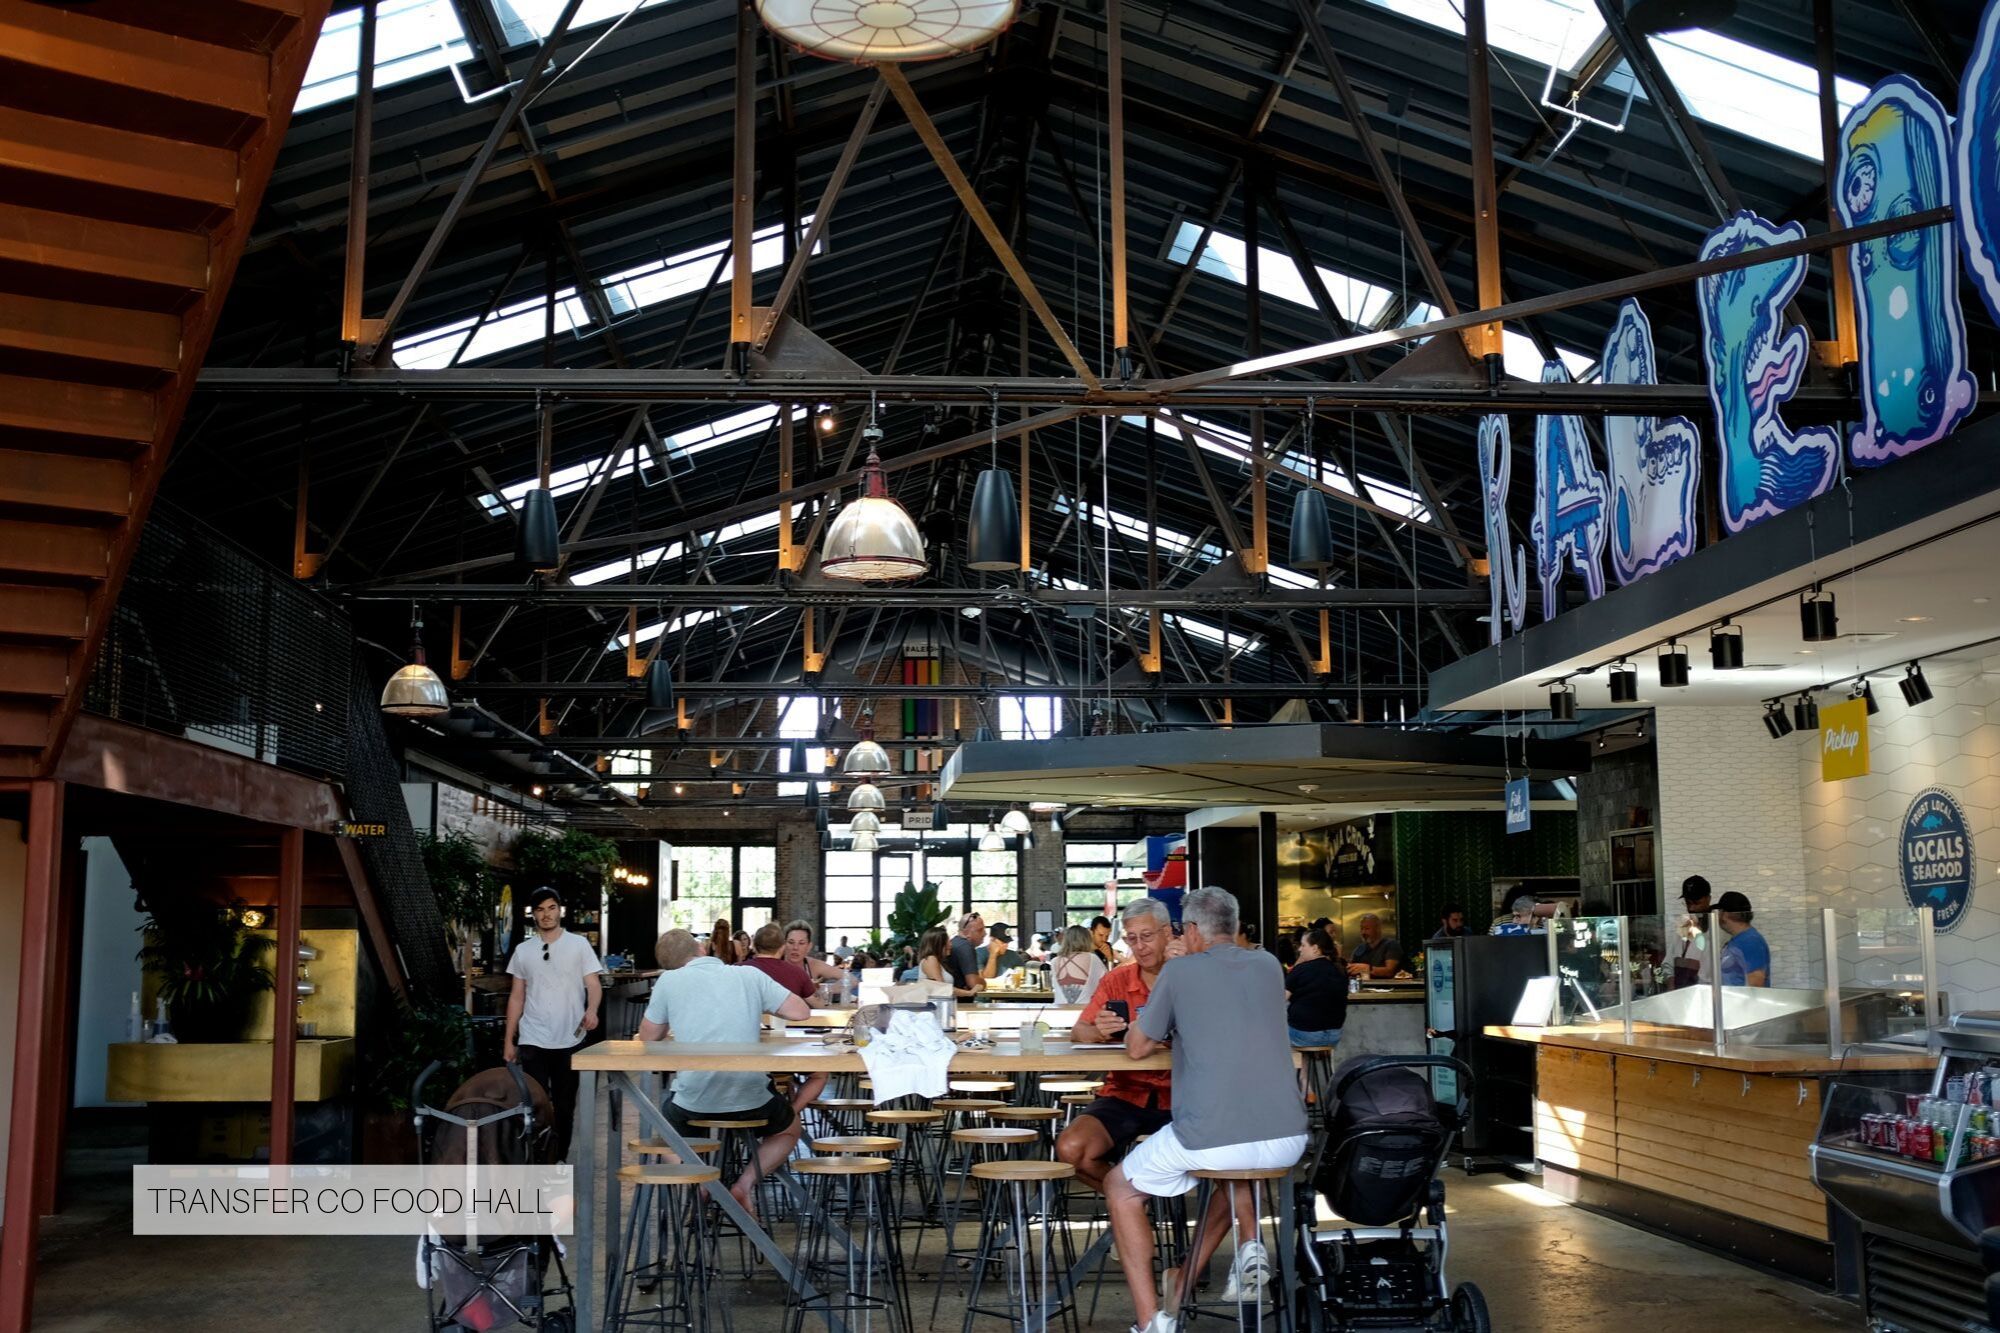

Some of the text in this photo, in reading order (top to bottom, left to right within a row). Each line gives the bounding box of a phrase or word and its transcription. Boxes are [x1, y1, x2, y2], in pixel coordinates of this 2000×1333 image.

[1824, 724, 1859, 757] Pickup
[908, 816, 932, 824] PRID
[1911, 801, 1929, 827] TRUST
[345, 824, 385, 836] WATER
[1908, 836, 1964, 863] LOCALS
[1912, 861, 1963, 881] SEAFOOD
